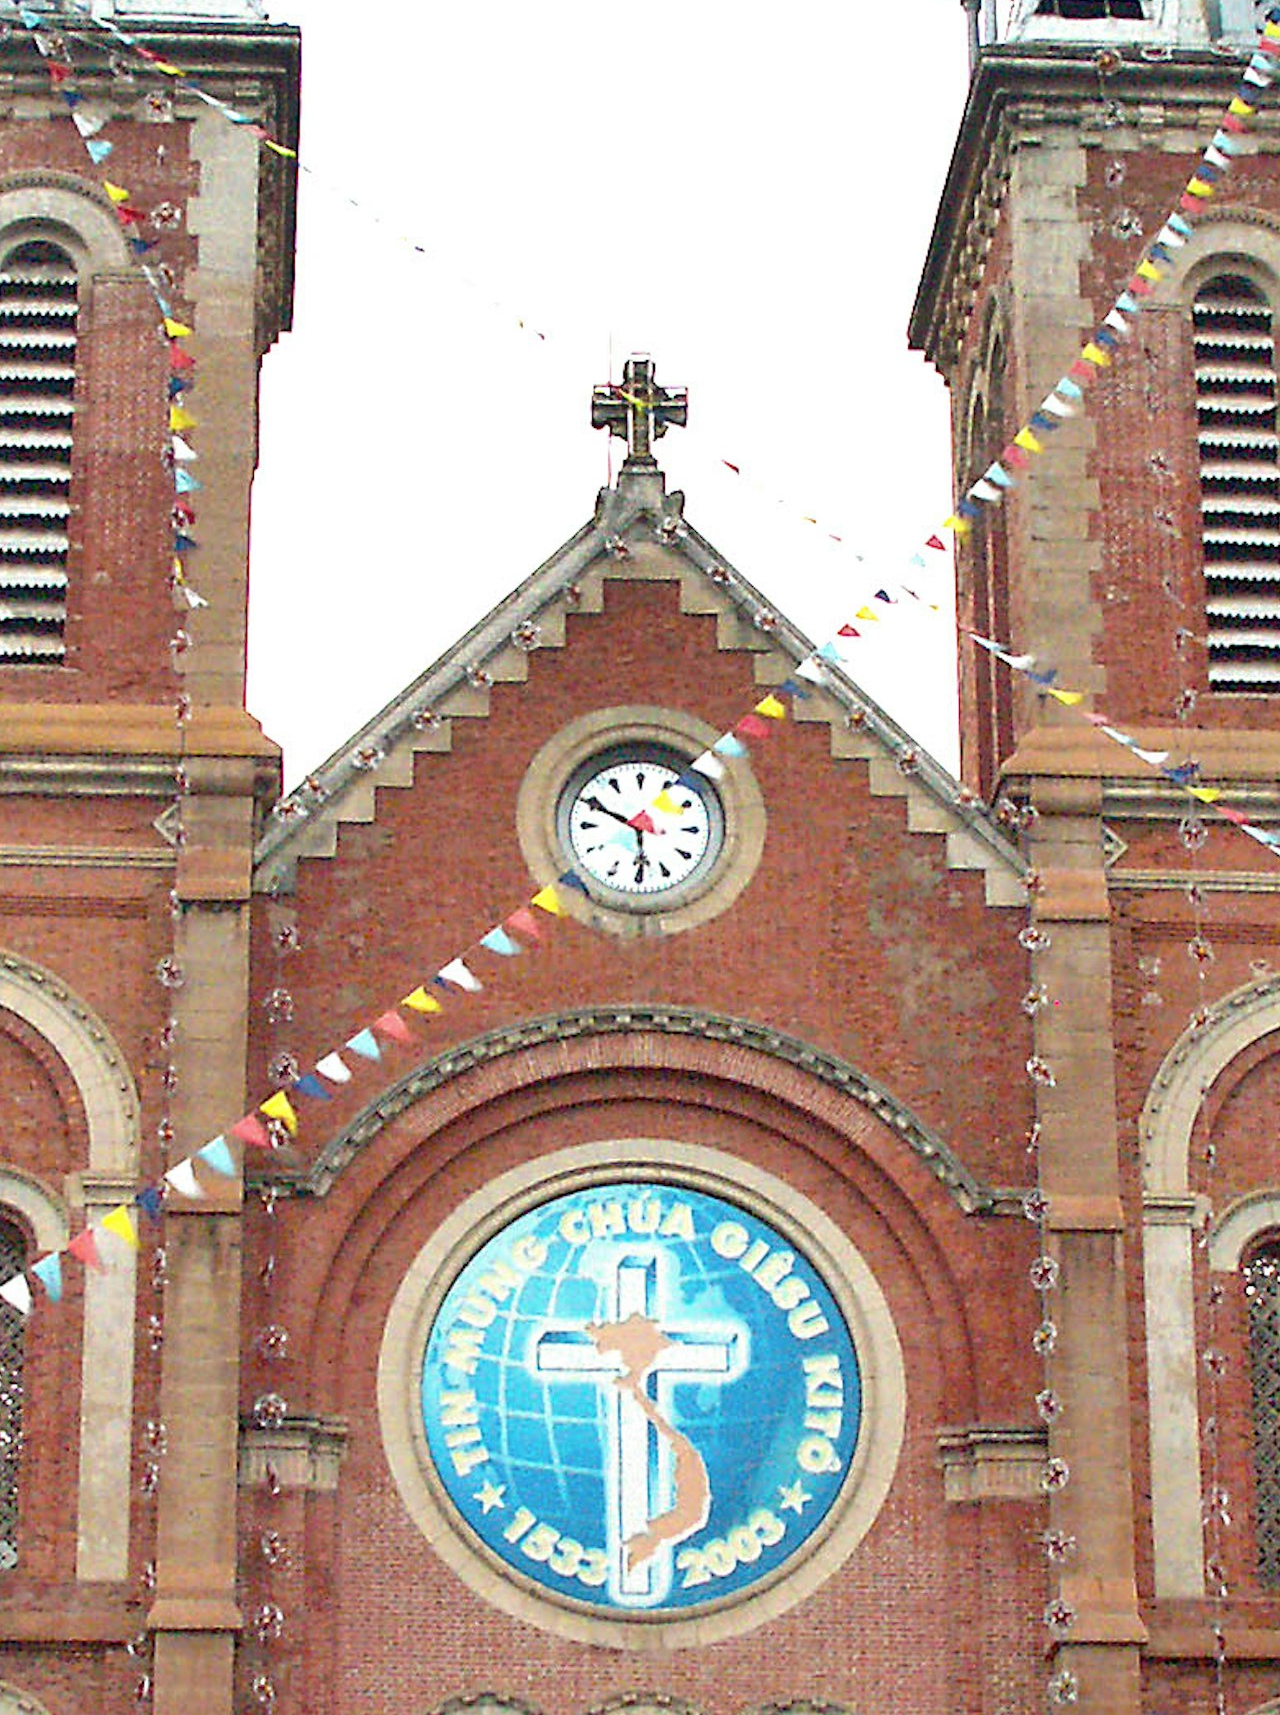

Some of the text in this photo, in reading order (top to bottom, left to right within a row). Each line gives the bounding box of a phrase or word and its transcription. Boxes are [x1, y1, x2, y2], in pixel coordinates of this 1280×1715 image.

[439, 1387, 490, 1477] TIN
[559, 1189, 696, 1244] CHÚA
[710, 1220, 831, 1340] GIÊSU
[502, 1505, 786, 1589] 1533 2003
